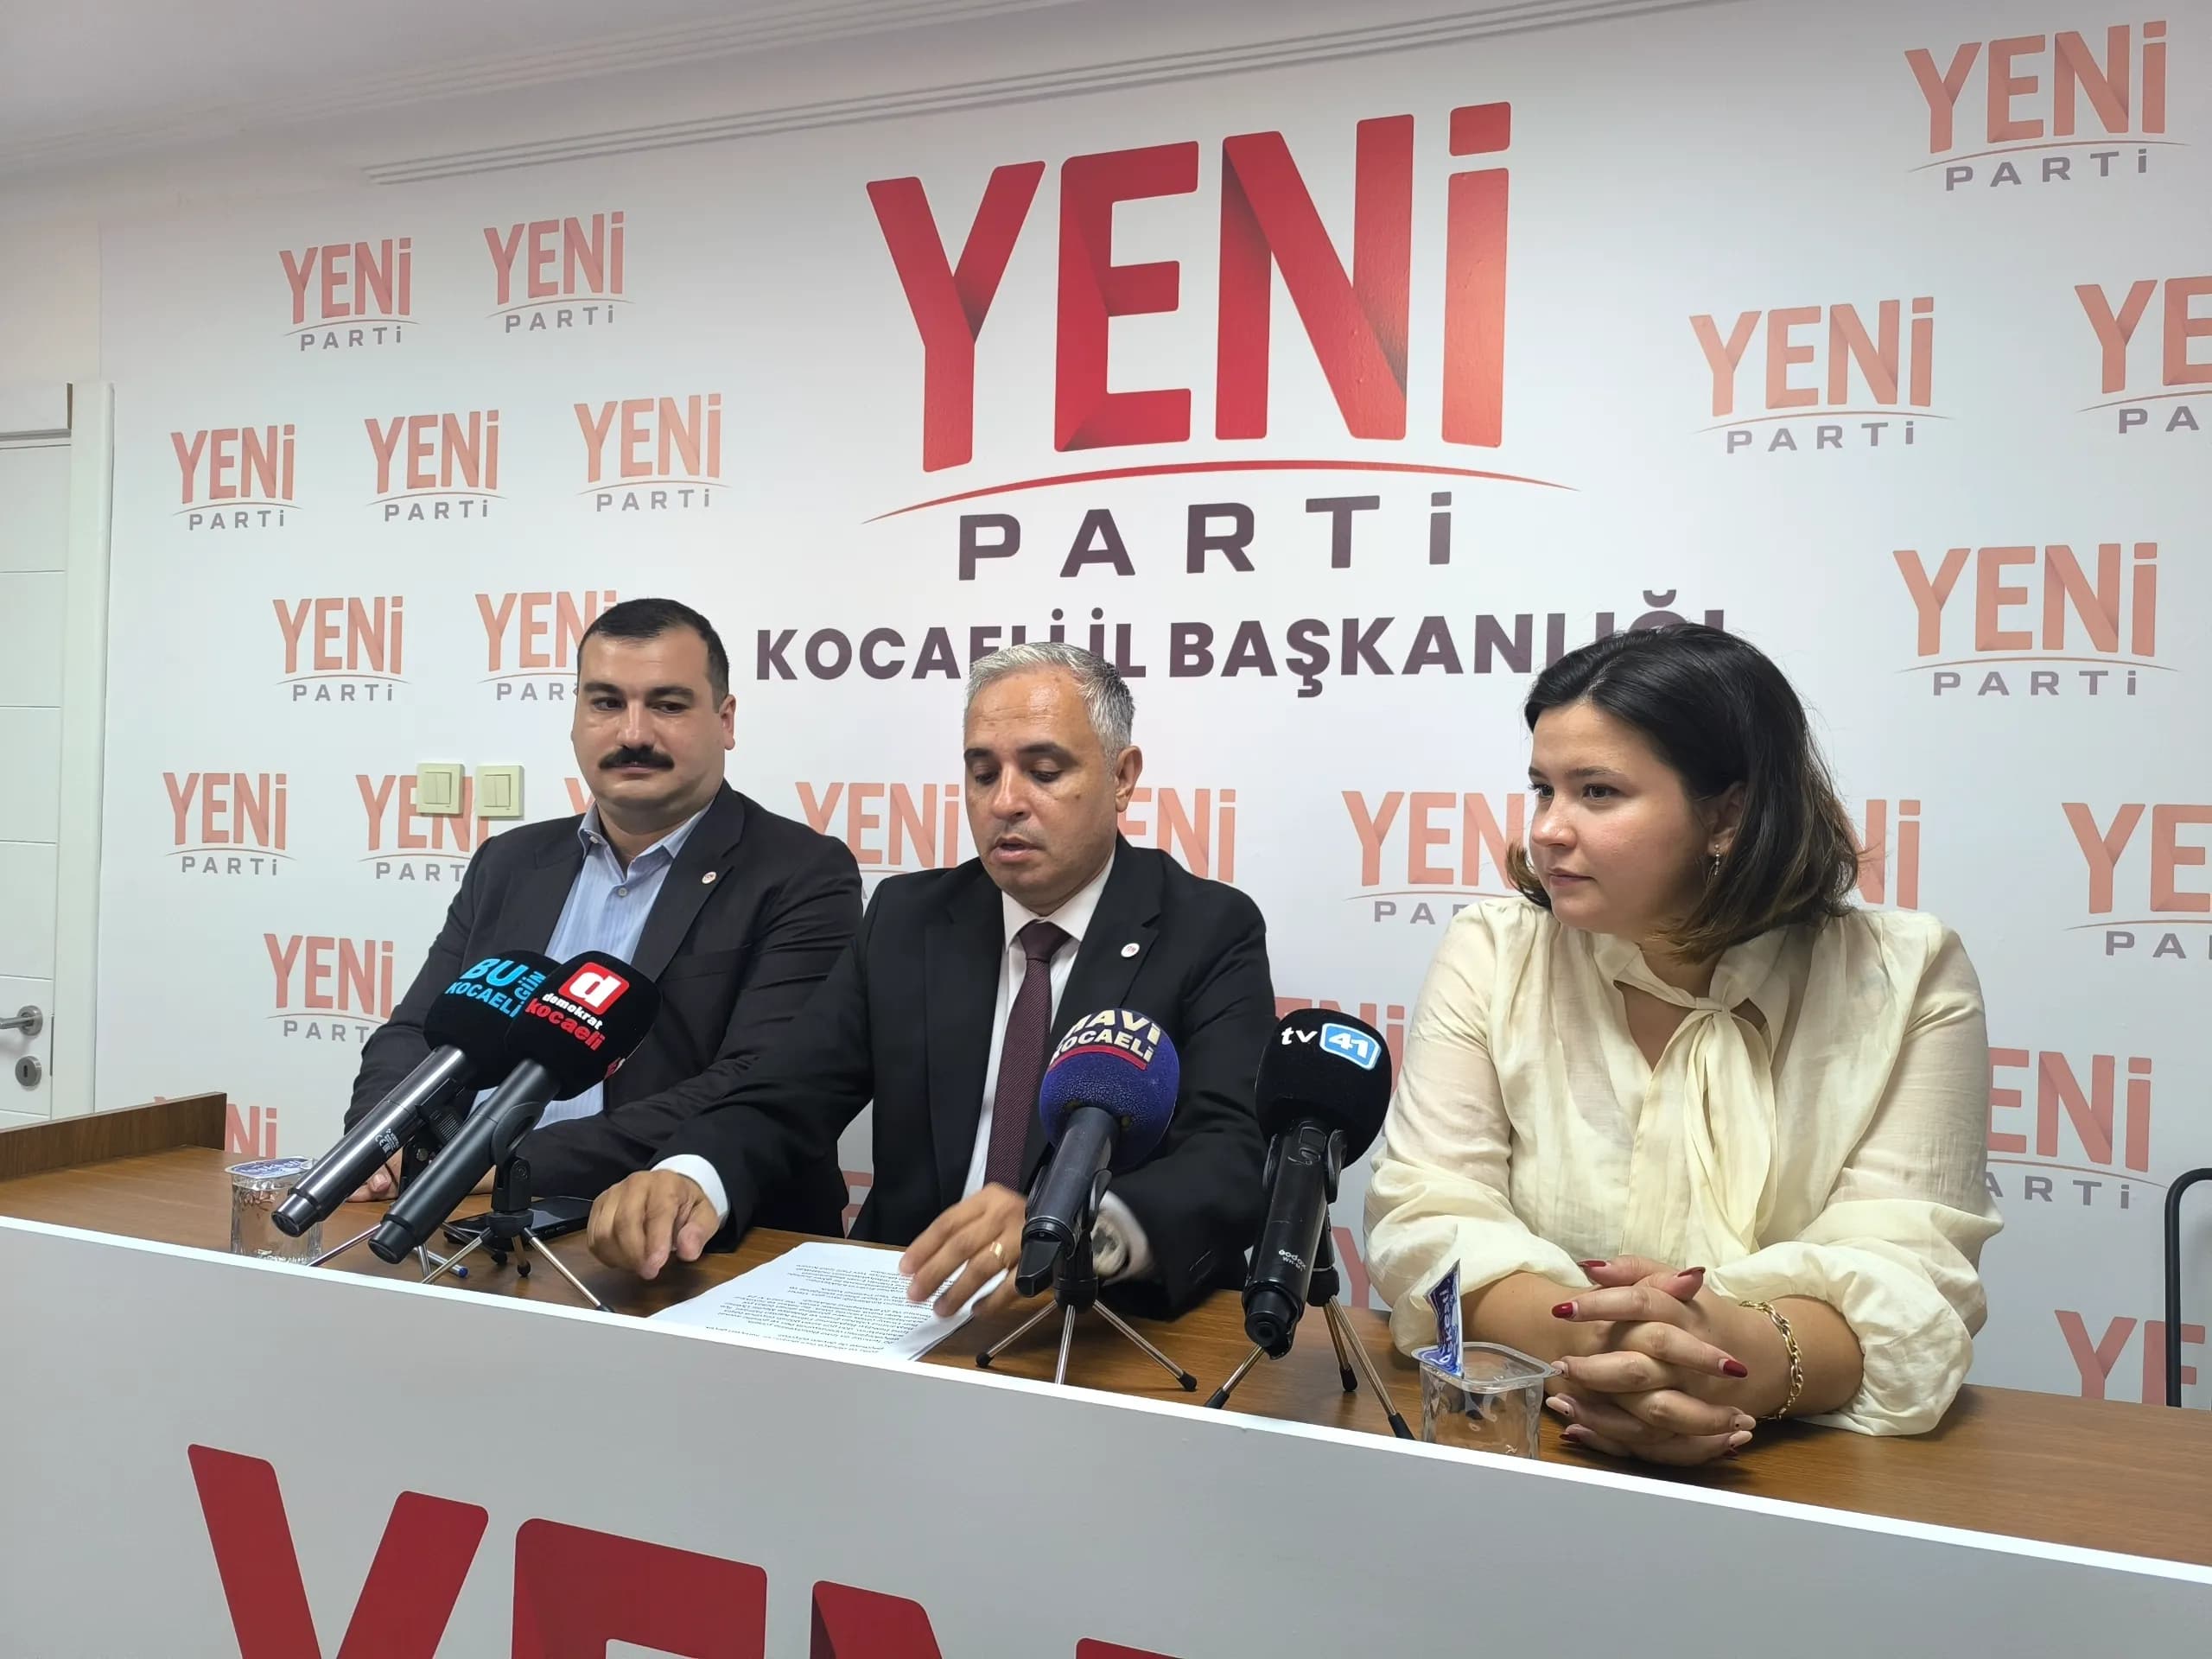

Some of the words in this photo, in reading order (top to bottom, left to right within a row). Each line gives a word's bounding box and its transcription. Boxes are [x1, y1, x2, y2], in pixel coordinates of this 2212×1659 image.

[2074, 275, 2212, 394] YE
[474, 590, 617, 671] YEN
[496, 683, 567, 701] PAR
[1341, 791, 1526, 891] YEN
[2061, 802, 2212, 914] YE
[376, 861, 466, 882] PART
[460, 957, 529, 987] BU
[514, 970, 547, 1001] GÜN
[524, 997, 606, 1052] kocaeli
[541, 992, 604, 1030] demokrat
[283, 1020, 370, 1044] PART
[1281, 1026, 1319, 1046] tv
[1328, 1032, 1370, 1059] 41
[1987, 1046, 2152, 1173] ENi
[1985, 1171, 2130, 1210] ARTi
[2054, 1309, 2206, 1408] YE
